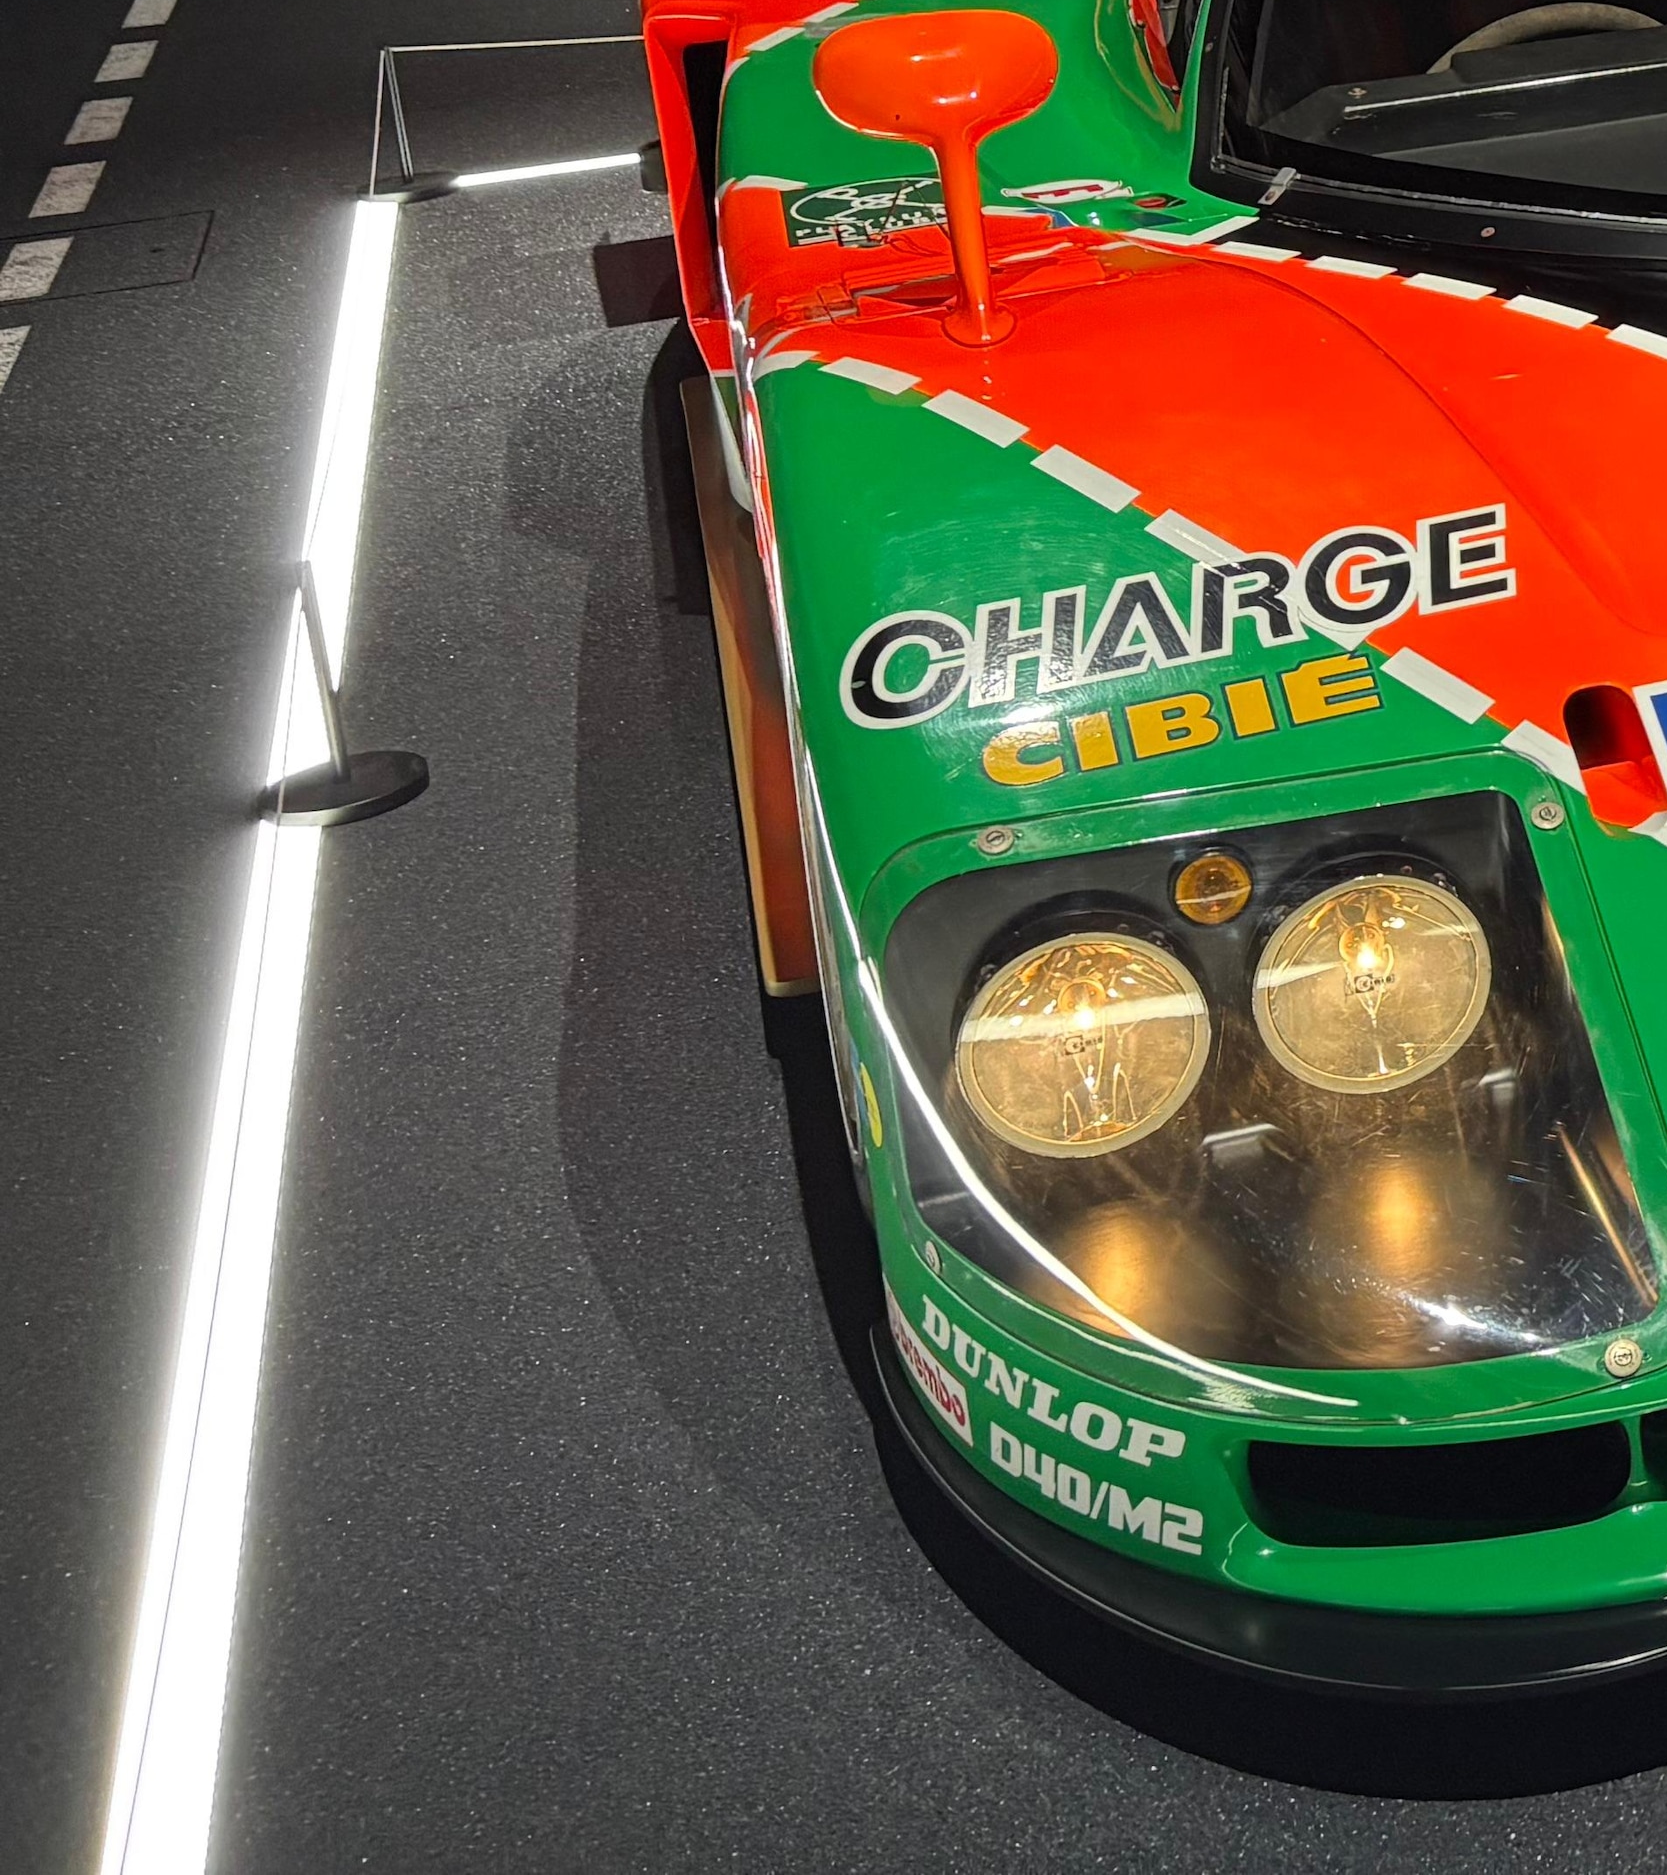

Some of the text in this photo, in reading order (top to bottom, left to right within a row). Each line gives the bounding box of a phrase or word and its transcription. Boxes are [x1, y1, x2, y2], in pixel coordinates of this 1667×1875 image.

[840, 503, 1517, 729] CHARGE
[922, 1294, 1186, 1467] DUNLOP
[990, 1421, 1203, 1556] D40/M2
